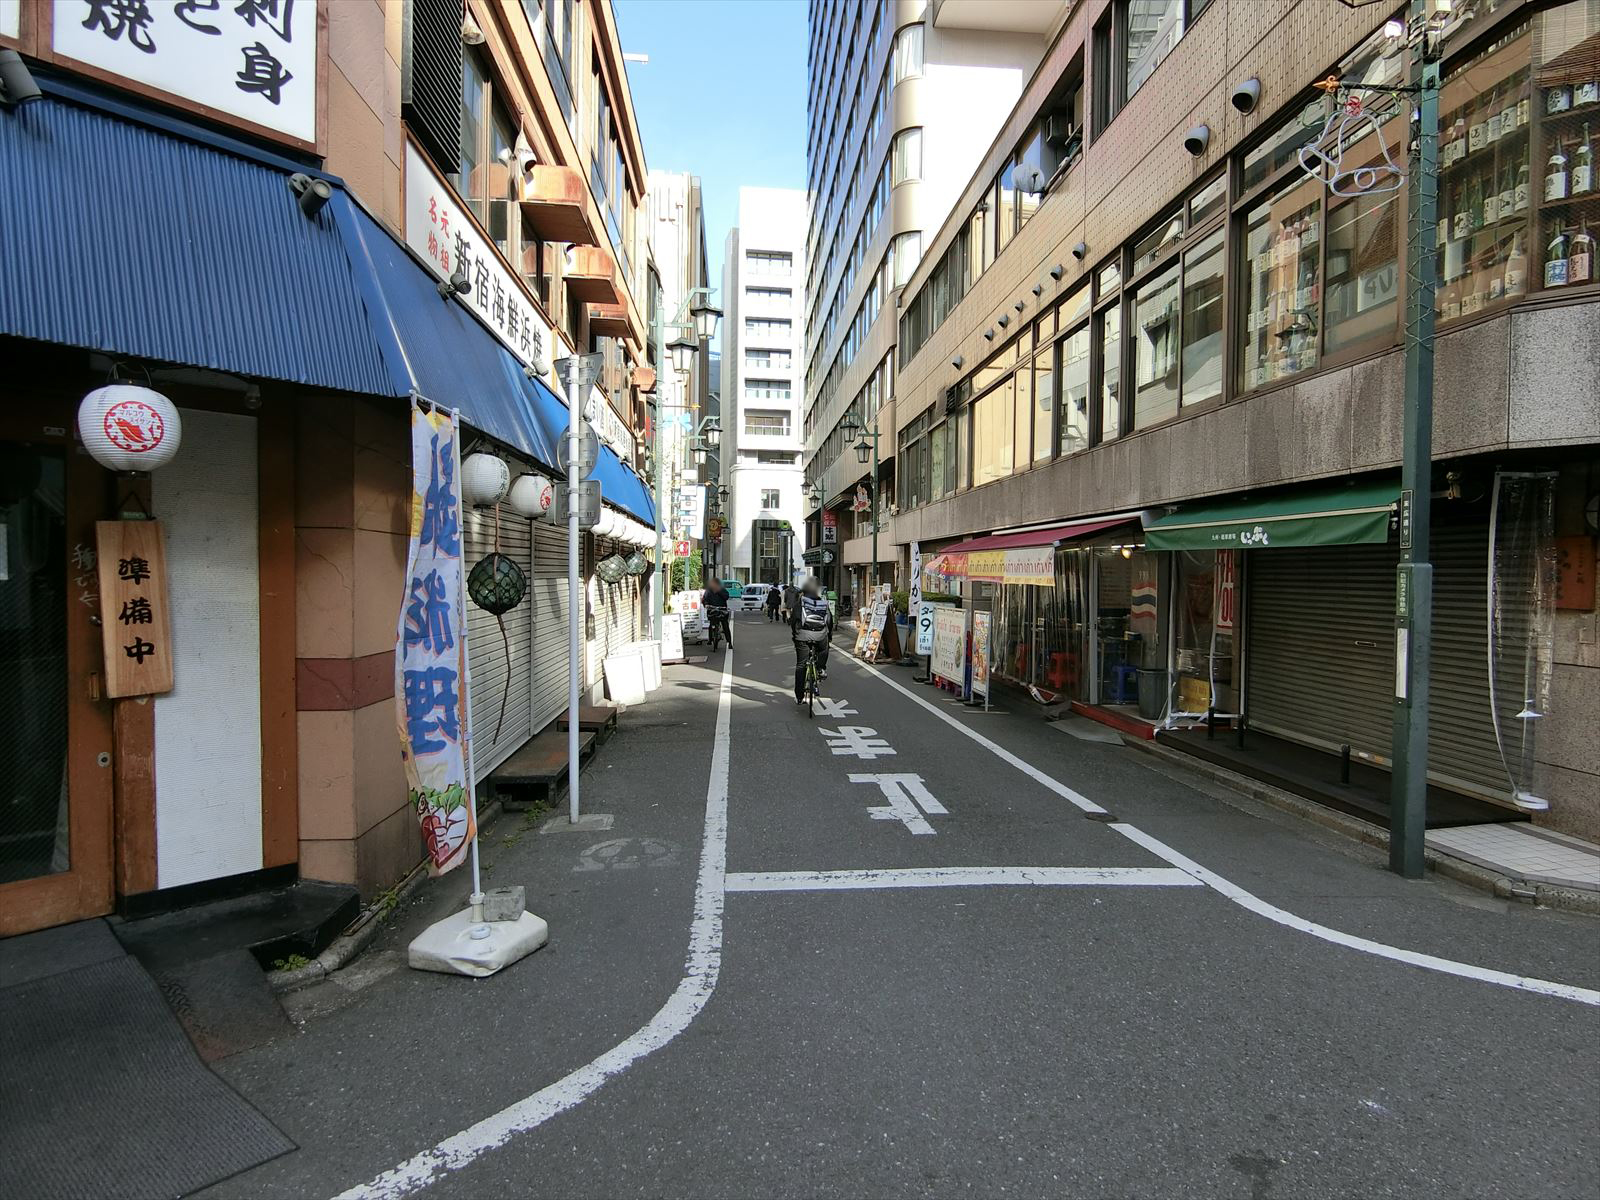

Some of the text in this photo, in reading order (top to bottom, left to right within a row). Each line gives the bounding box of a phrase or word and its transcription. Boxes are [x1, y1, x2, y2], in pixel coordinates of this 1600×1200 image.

[428, 196, 439, 260] 名物
[440, 210, 451, 274] 元祖
[1240, 526, 1269, 545] いっぷく
[118, 555, 155, 665] 準備中
